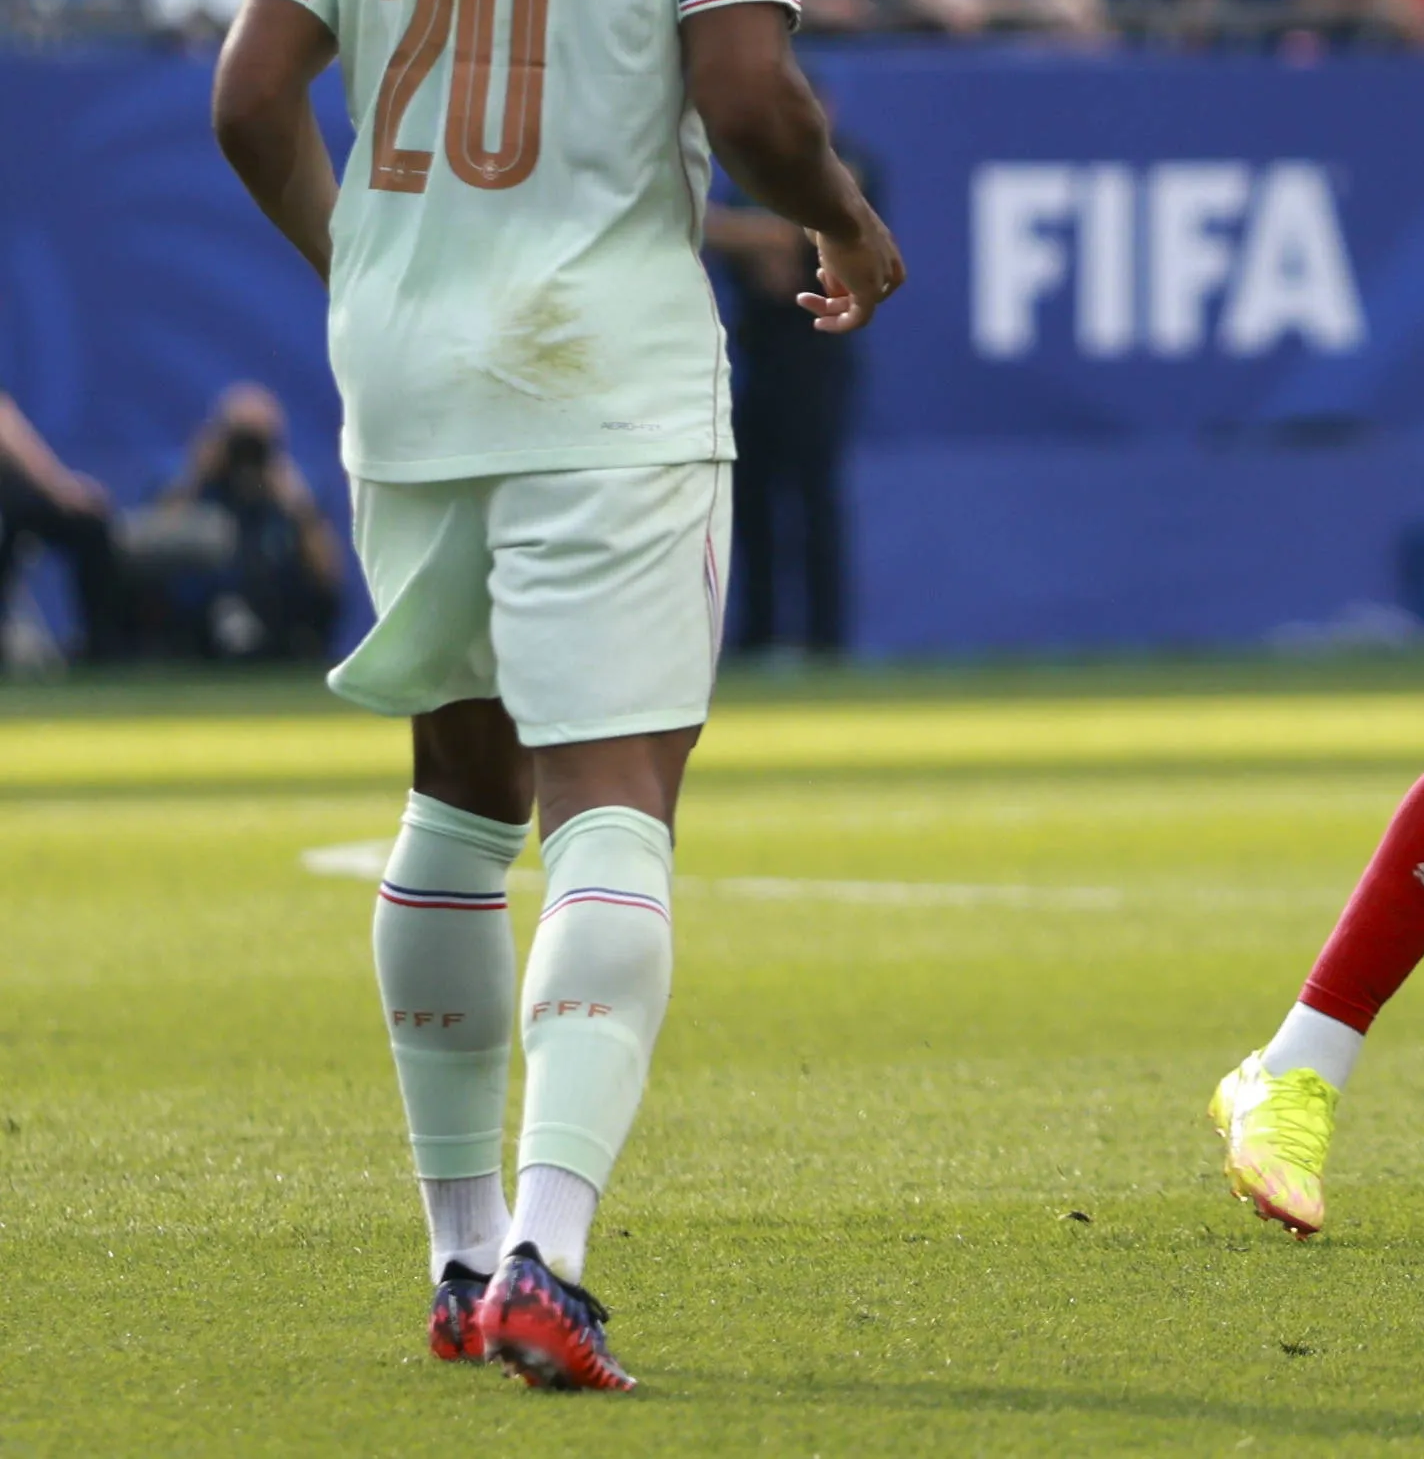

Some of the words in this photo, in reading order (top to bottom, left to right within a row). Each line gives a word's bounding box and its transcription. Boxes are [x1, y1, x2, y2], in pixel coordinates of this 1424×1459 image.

[971, 159, 1367, 358] FIFA
[393, 1010, 465, 1028] FFF
[532, 1000, 612, 1021] FFF
